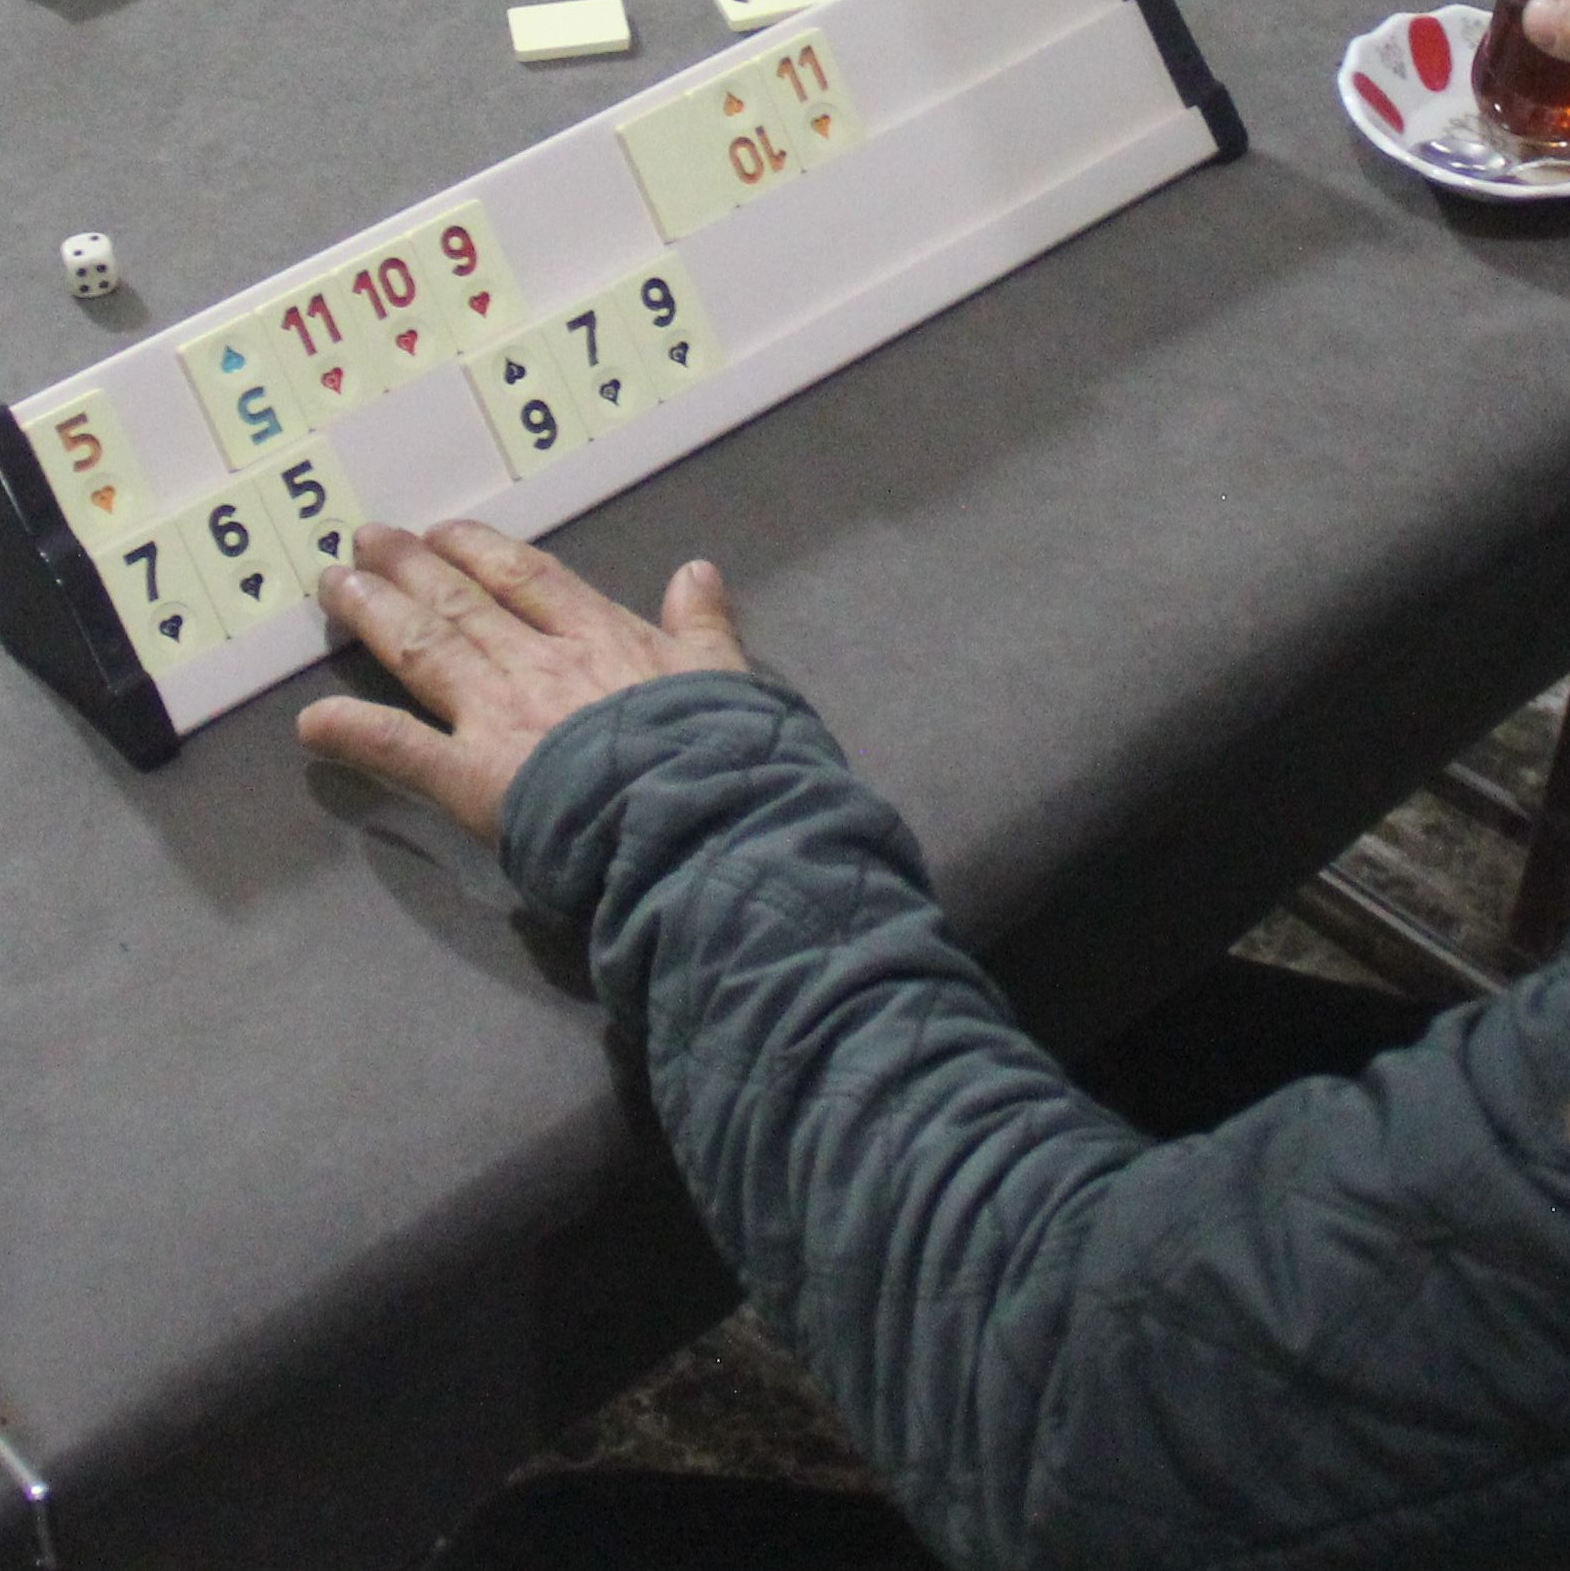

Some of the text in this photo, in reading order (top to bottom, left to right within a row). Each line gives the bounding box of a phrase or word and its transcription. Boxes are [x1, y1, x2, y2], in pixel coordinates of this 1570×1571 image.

[776, 45, 829, 102] 11
[439, 225, 477, 277] 9
[352, 256, 417, 321] 10
[640, 277, 677, 327] 9
[281, 293, 344, 356] 11
[566, 310, 600, 366] 7
[56, 412, 104, 472] 5
[281, 460, 327, 519] 5
[208, 504, 251, 558] 6
[123, 541, 160, 603] 7
